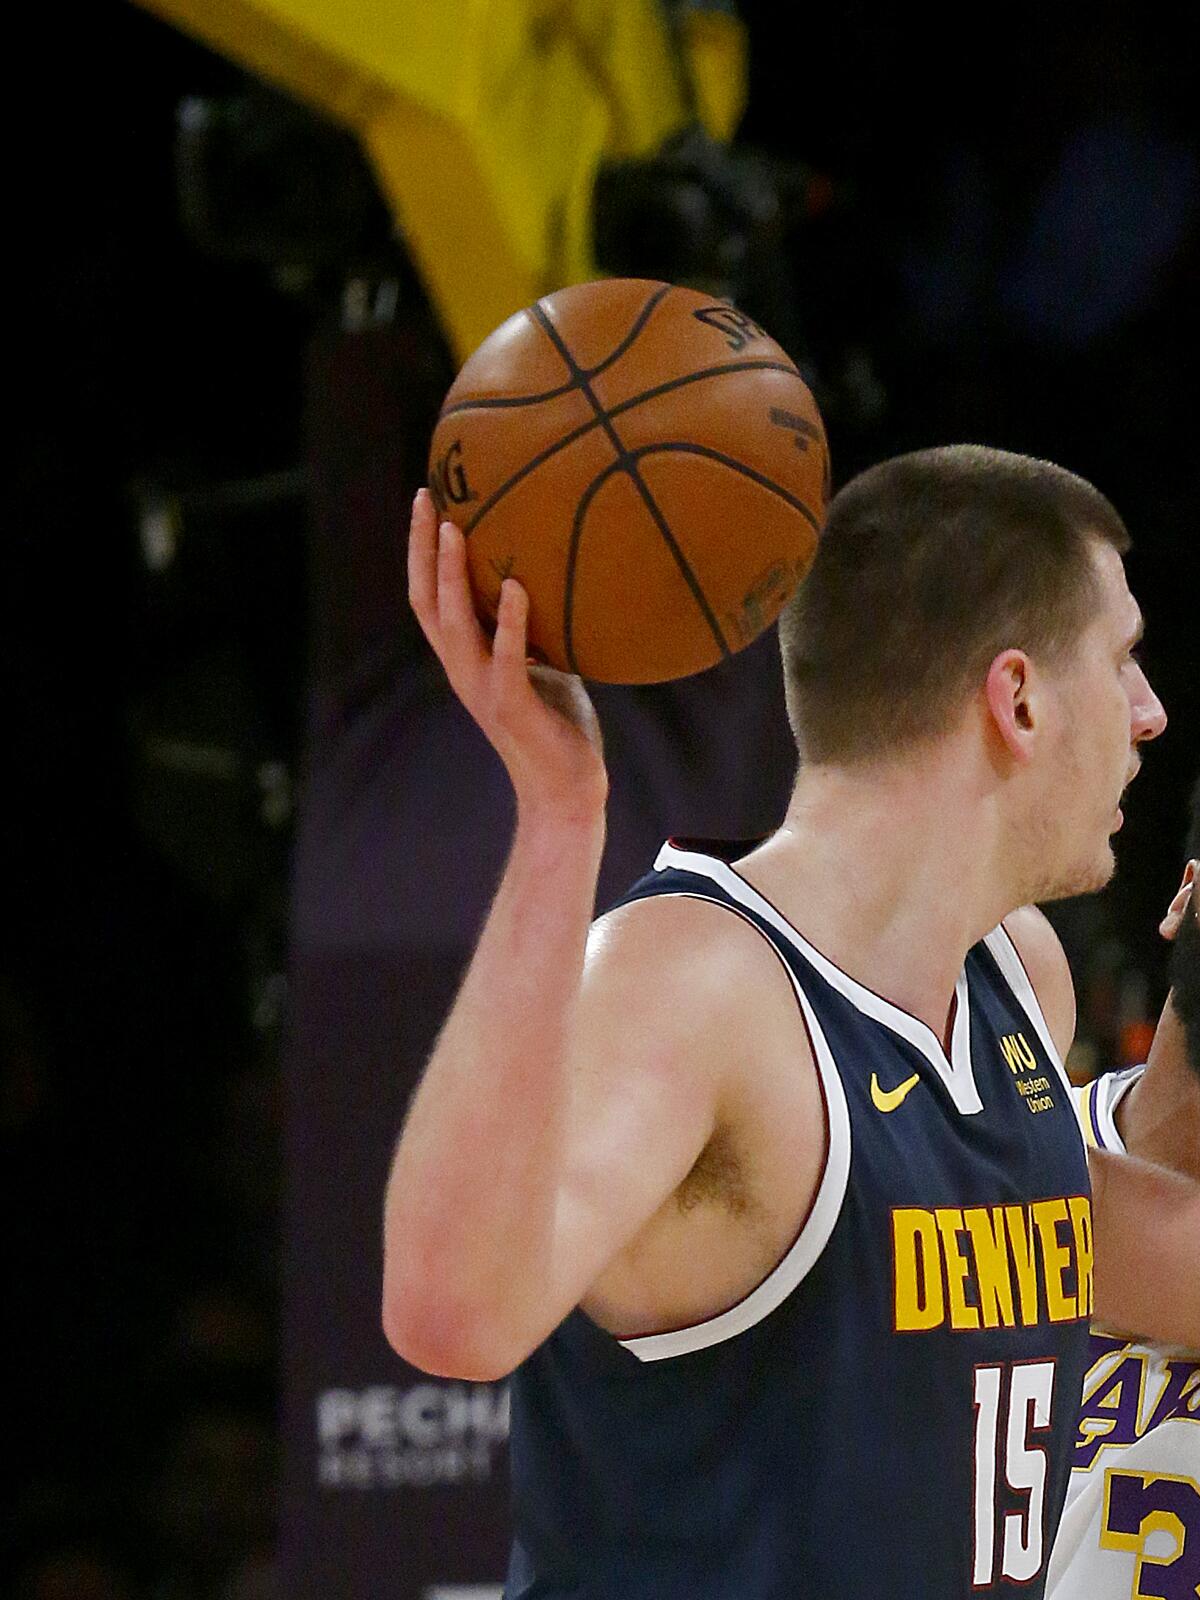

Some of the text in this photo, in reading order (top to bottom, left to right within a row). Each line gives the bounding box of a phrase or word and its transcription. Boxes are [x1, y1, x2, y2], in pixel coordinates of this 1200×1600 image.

[999, 1032, 1037, 1075] WU
[1015, 1077, 1051, 1097] Western
[1026, 1094, 1055, 1114] Union
[890, 1195, 1094, 1333] DENVER
[972, 1356, 1057, 1592] 15
